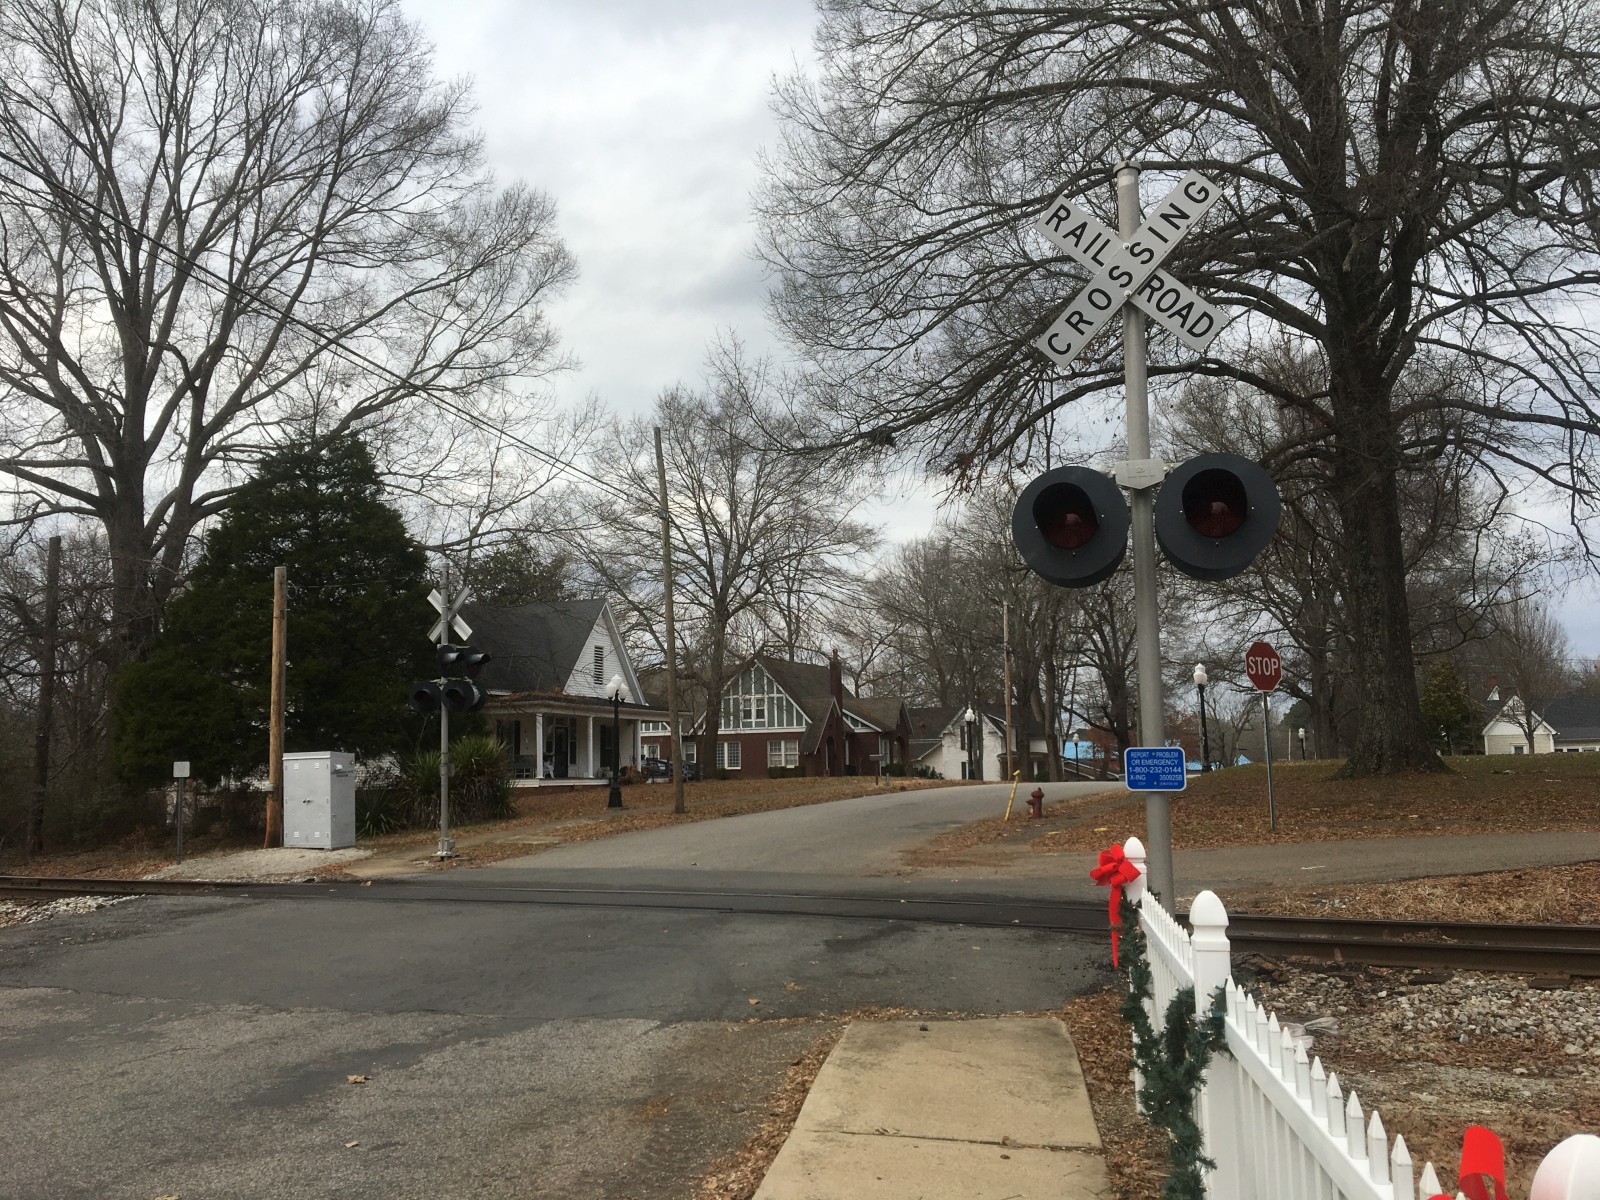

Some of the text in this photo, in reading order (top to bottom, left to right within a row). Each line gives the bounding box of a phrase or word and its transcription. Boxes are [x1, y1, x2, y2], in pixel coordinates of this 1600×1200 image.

[1045, 203, 1214, 338] RAIL ROAD
[1047, 181, 1210, 356] CROSSING
[1248, 656, 1279, 676] STOP
